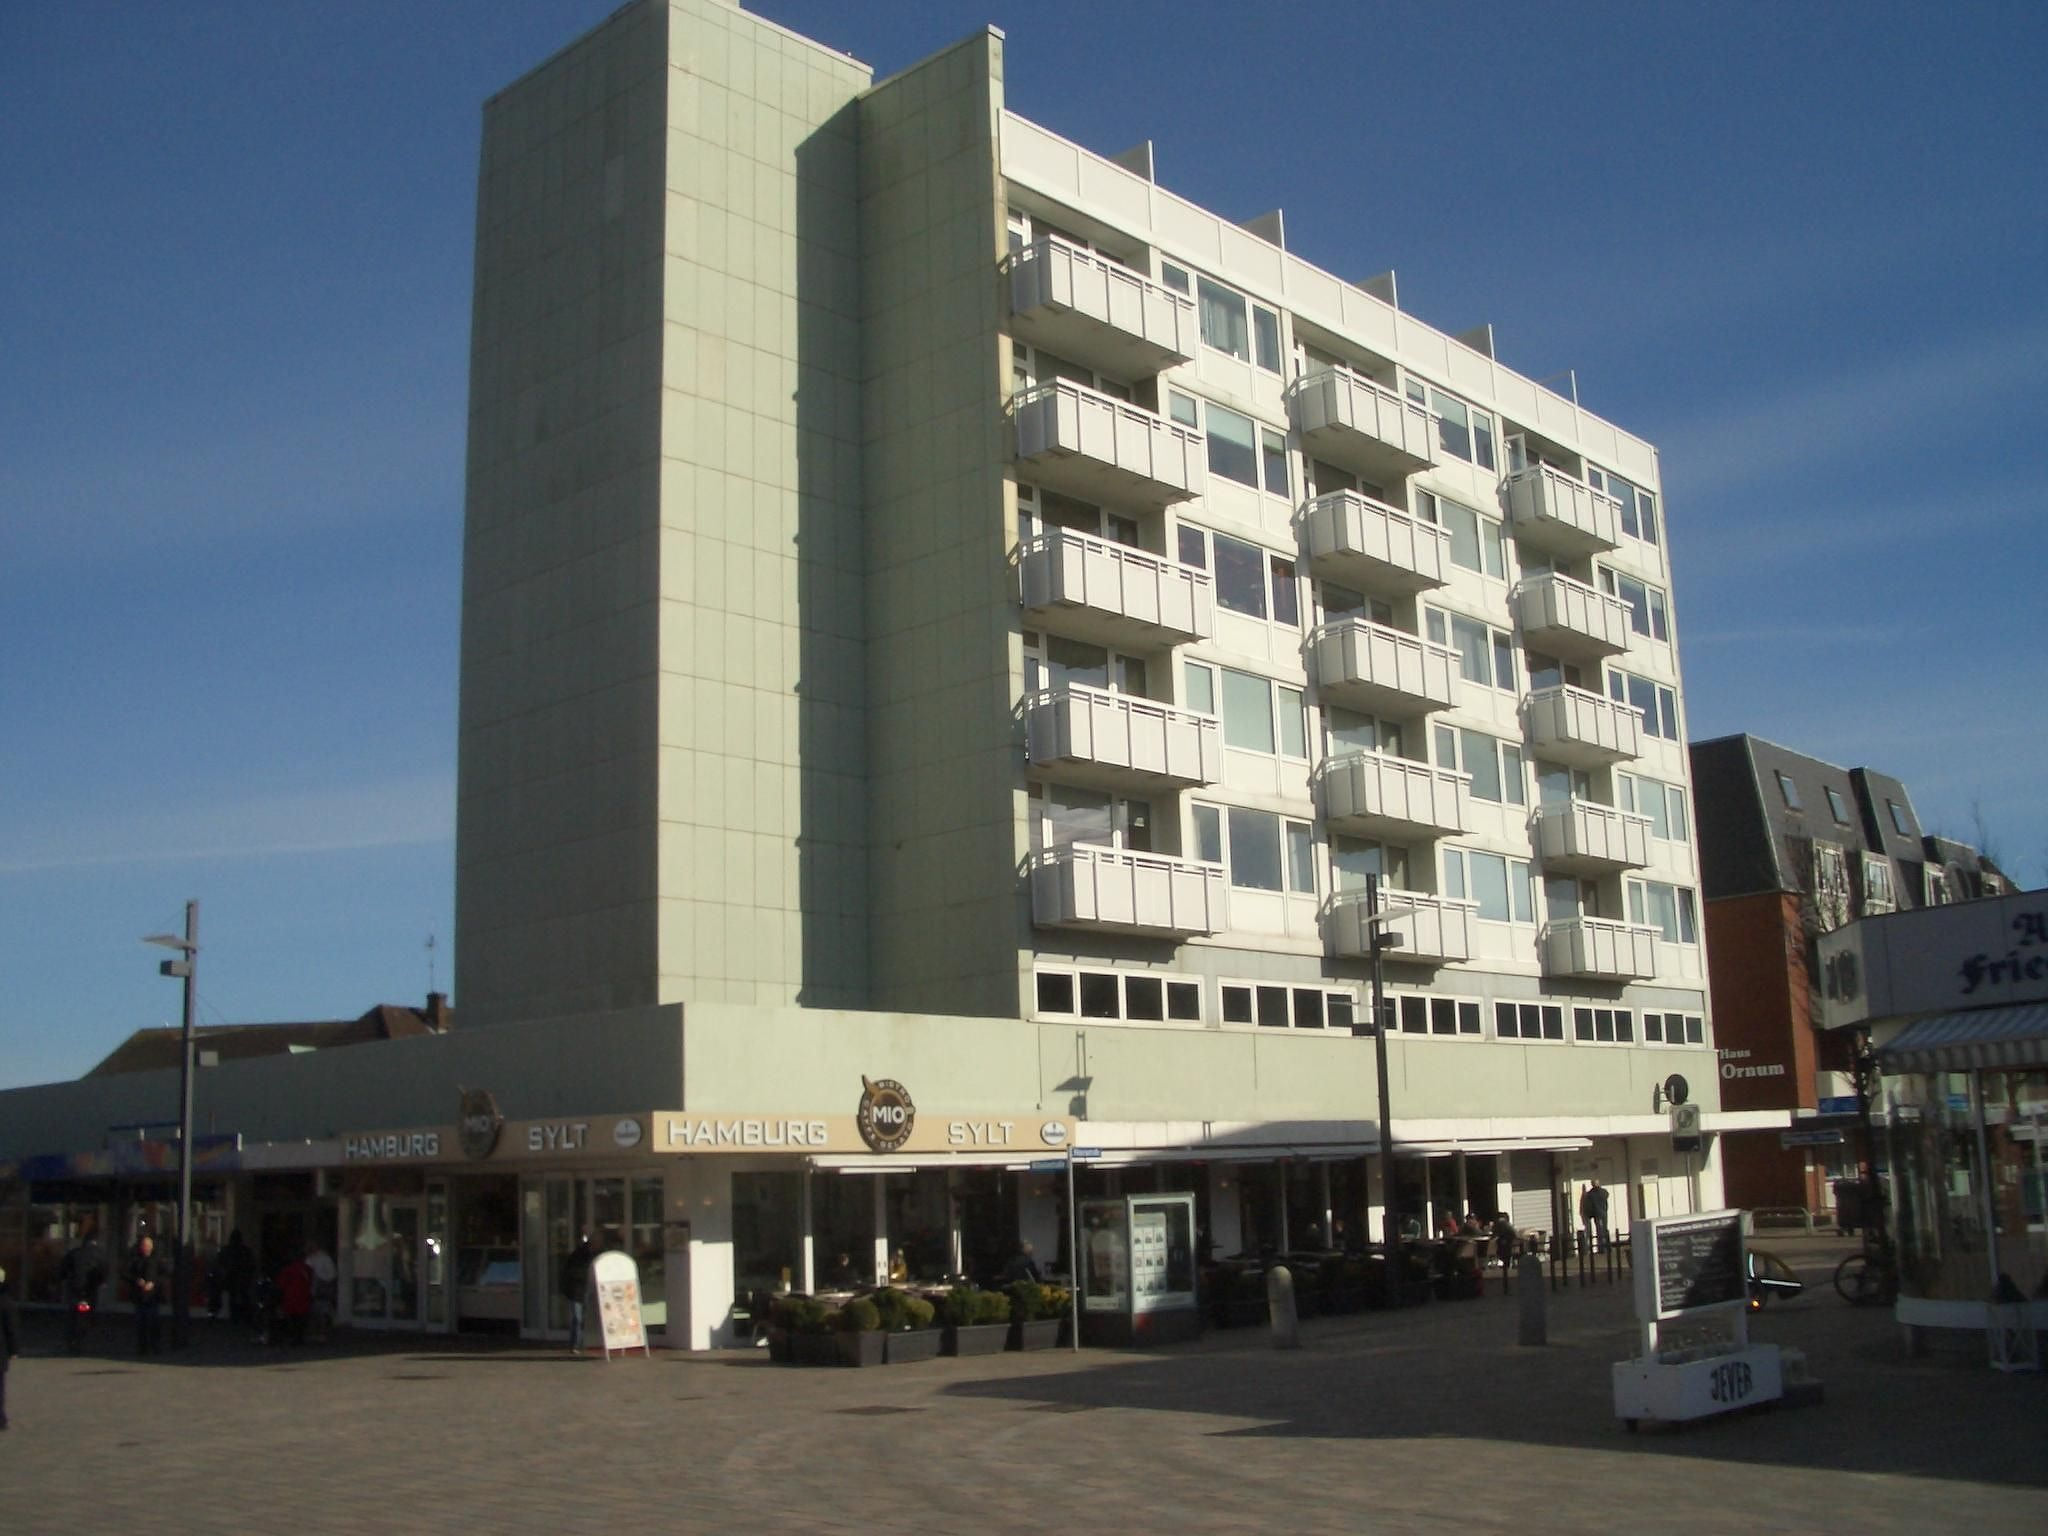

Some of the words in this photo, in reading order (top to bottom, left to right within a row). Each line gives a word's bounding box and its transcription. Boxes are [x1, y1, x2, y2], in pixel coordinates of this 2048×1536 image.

[1720, 1048, 1751, 1059] Haus
[1721, 1063, 1785, 1079] Ornum
[872, 1105, 906, 1124] MIO
[345, 1132, 439, 1159] HAMBURG
[528, 1123, 588, 1150] SYLT
[668, 1119, 828, 1145] HAMBURG
[948, 1120, 1015, 1145] SYLT
[1710, 1361, 1752, 1402] JEVER
